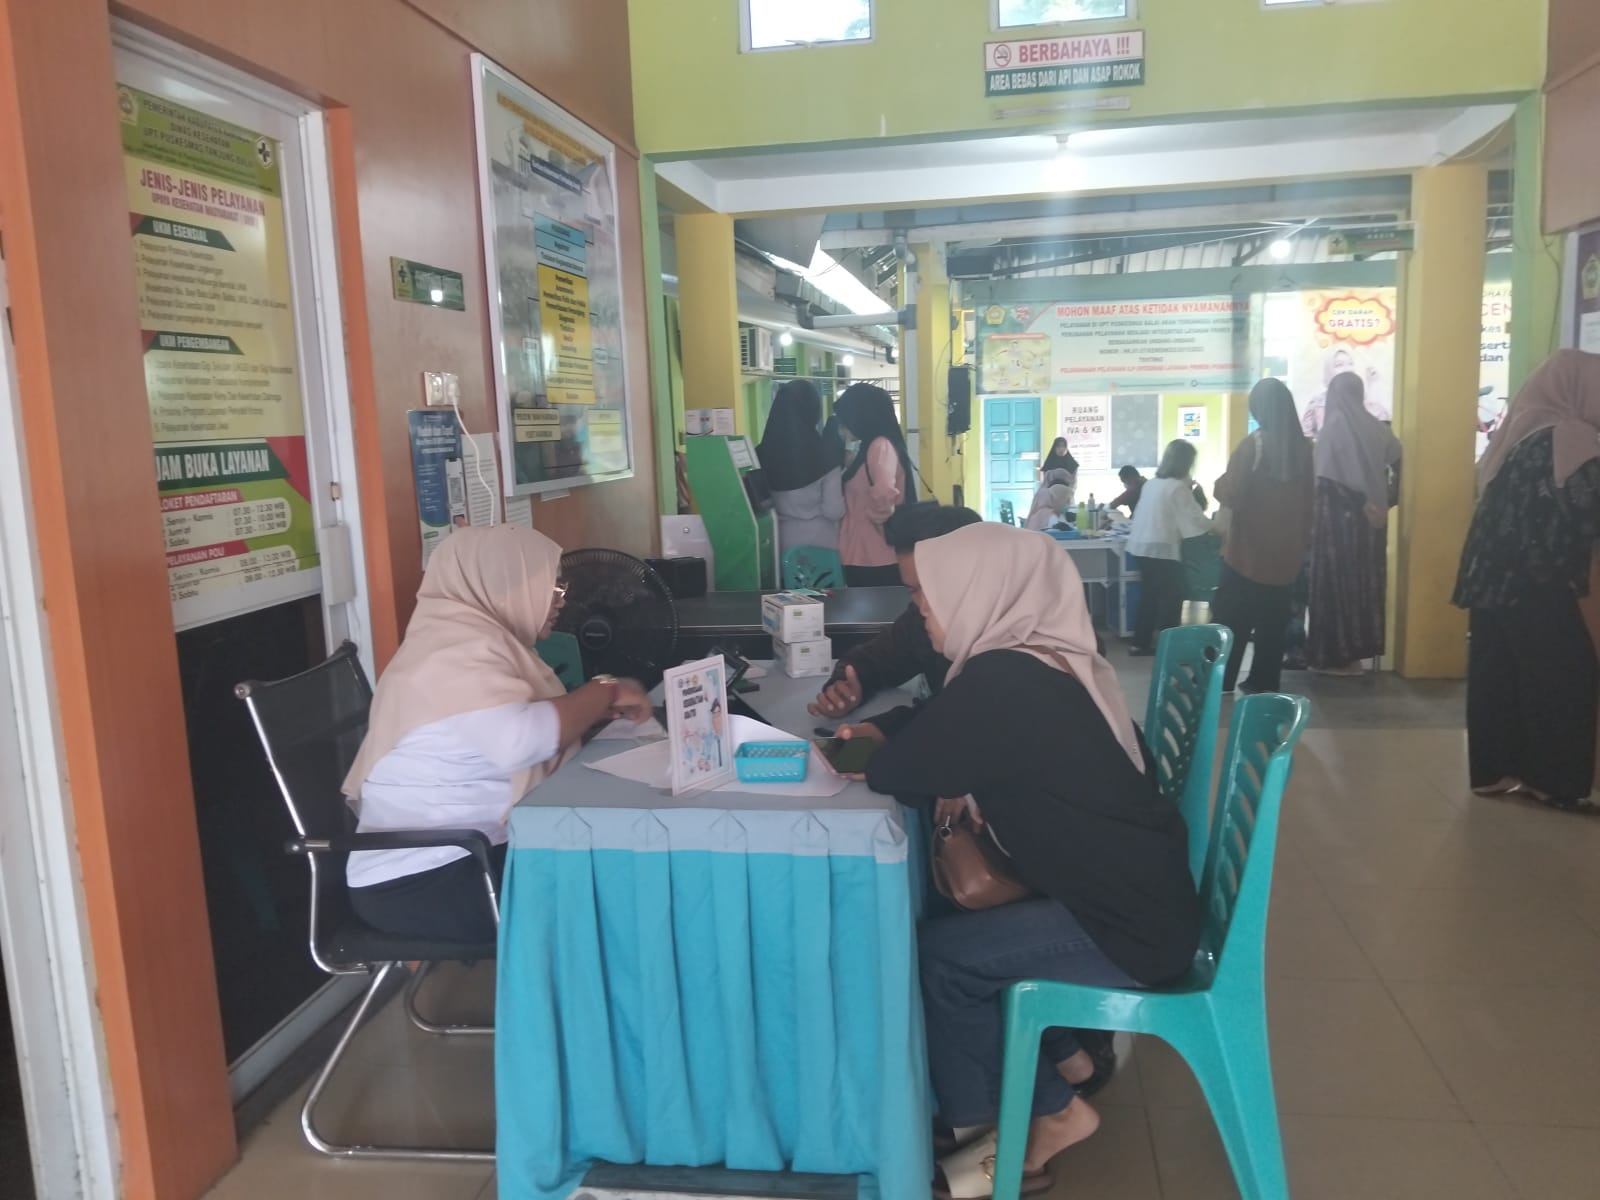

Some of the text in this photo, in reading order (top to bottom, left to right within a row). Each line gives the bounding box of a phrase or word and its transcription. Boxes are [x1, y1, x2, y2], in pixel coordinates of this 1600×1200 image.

[1019, 36, 1130, 63] BERBAHAYA !!!
[990, 63, 1141, 91] AREA BEBAS DARI API DAN ASAP ROKOK
[140, 168, 265, 216] JENIS-JENIS PELAYANAN
[1056, 306, 1089, 317] MOHON
[1092, 305, 1117, 316] MAAF
[1119, 304, 1140, 315] ATAS
[1142, 303, 1177, 314] KETIDAK
[1064, 415, 1105, 423] PELAYANAN
[156, 449, 270, 481] JAM BUKA LAYANAN
[185, 491, 238, 508] PENDAFTARAN
